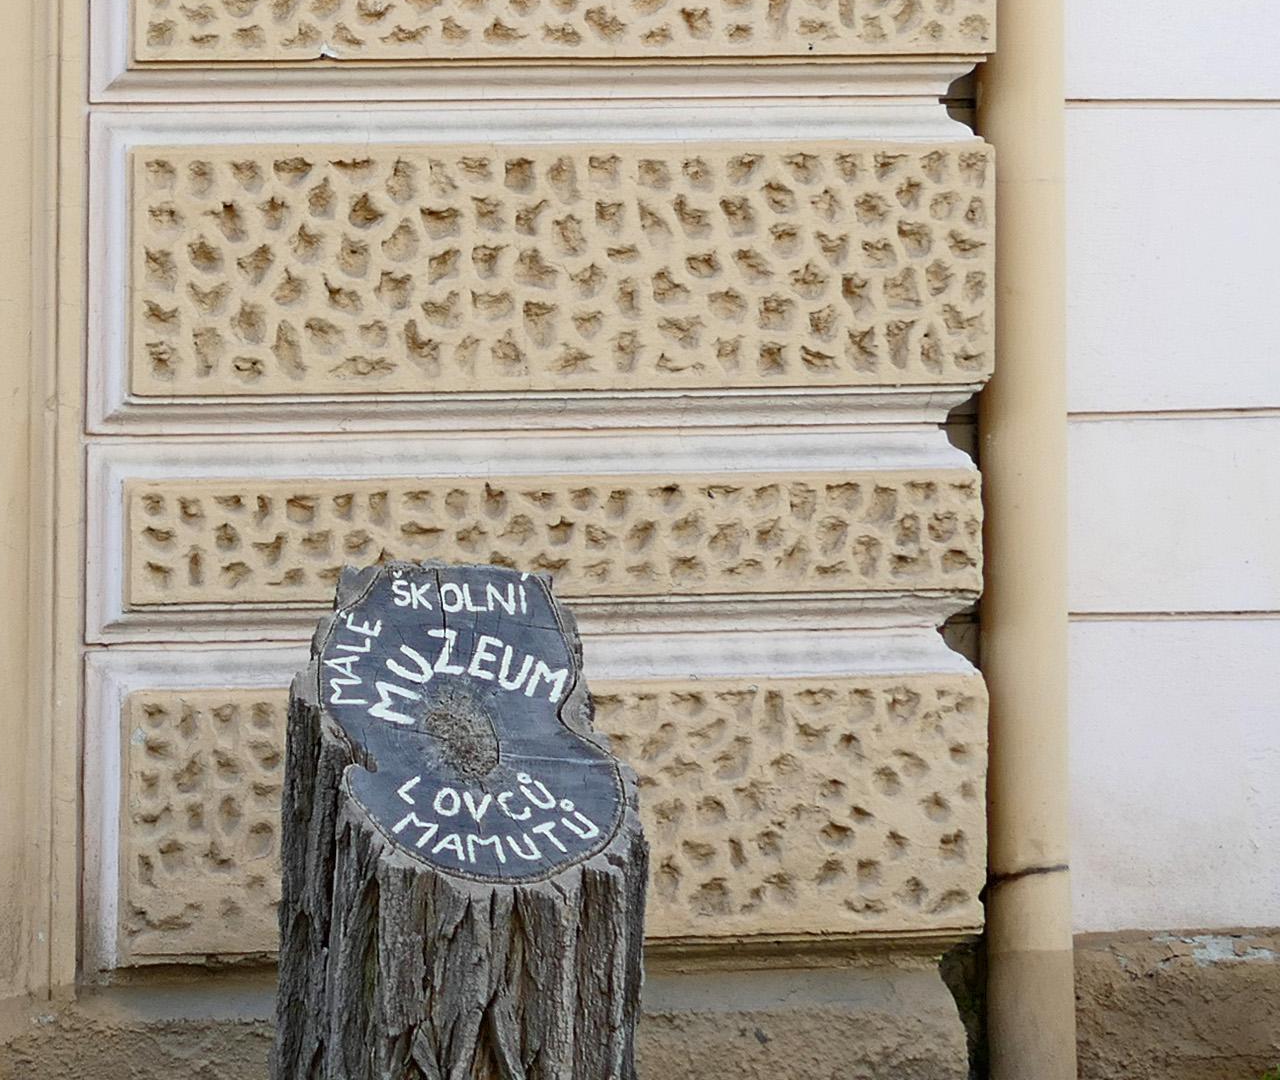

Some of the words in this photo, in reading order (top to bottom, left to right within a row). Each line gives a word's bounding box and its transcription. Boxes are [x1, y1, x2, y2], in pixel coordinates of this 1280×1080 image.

[323, 610, 383, 706] MALÉ
[391, 571, 530, 615] ŠKOLNÍ
[368, 629, 569, 725] MUZEUM
[392, 799, 600, 864] MAMUTŮ
[397, 772, 557, 822] LOVCŮ
